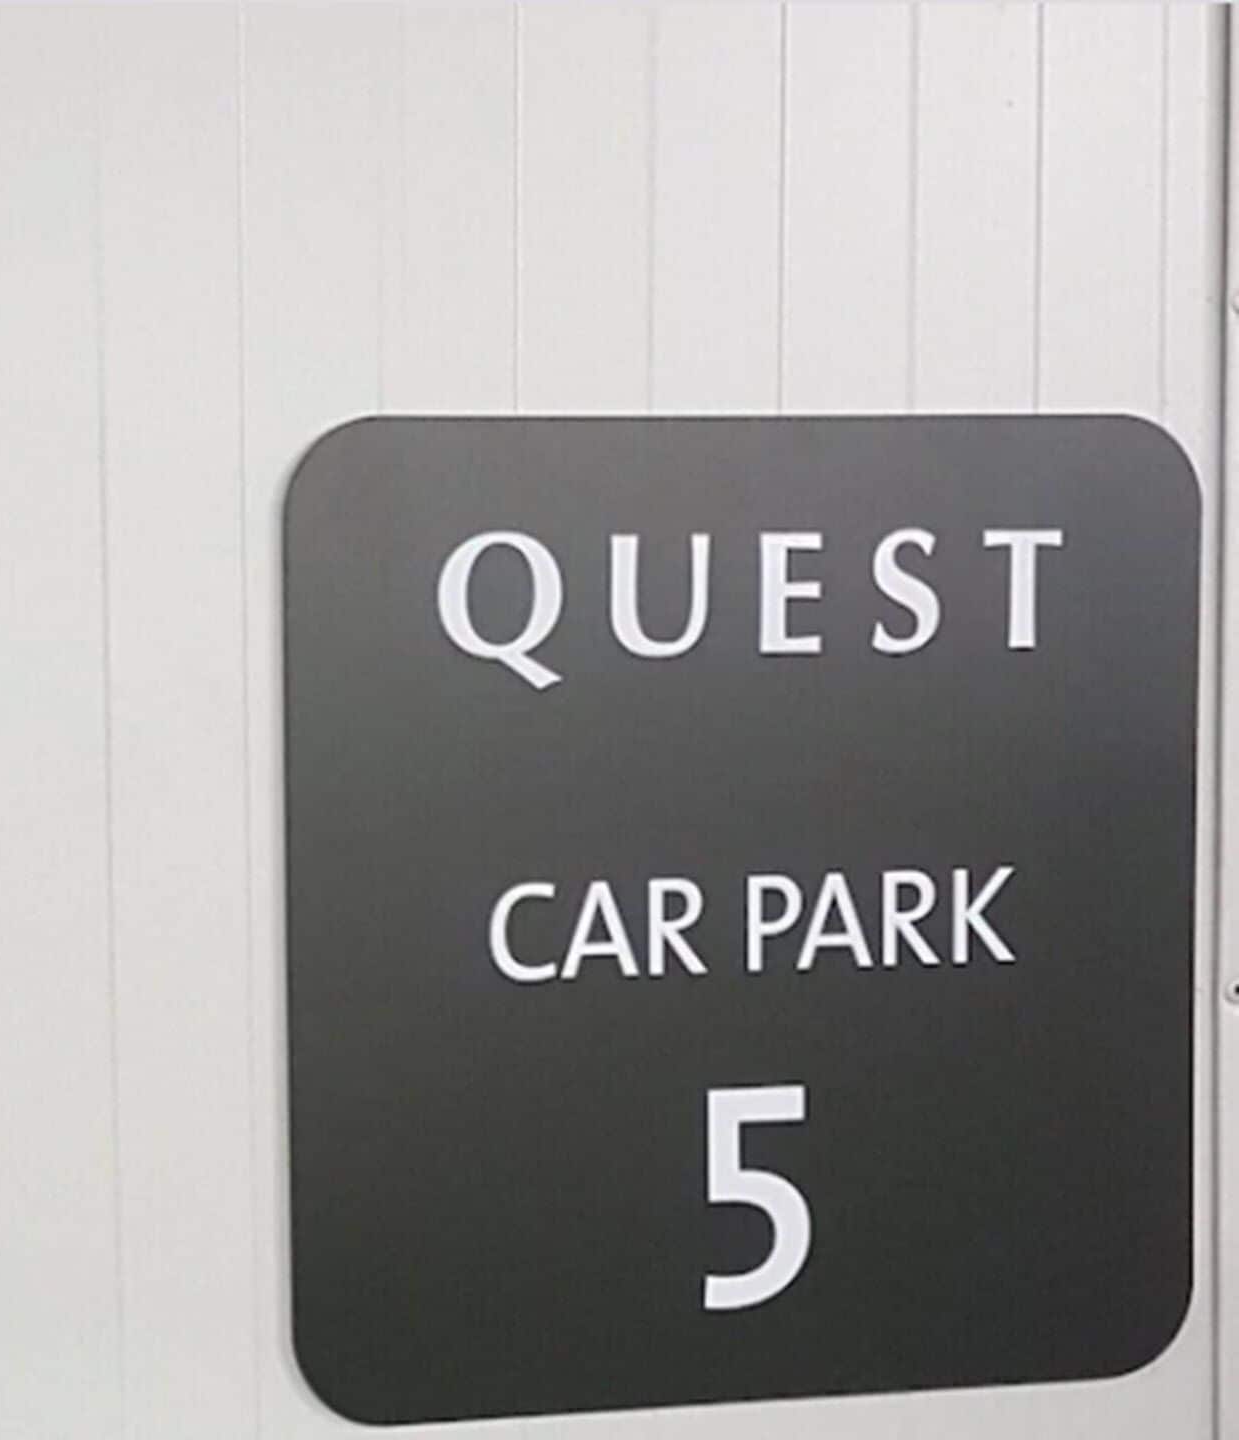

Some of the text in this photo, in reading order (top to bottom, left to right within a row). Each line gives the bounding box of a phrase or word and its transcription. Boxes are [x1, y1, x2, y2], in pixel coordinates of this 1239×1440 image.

[437, 527, 1064, 689] QUEST
[490, 866, 1016, 982] CAR PARK
[704, 1084, 812, 1311] 5
